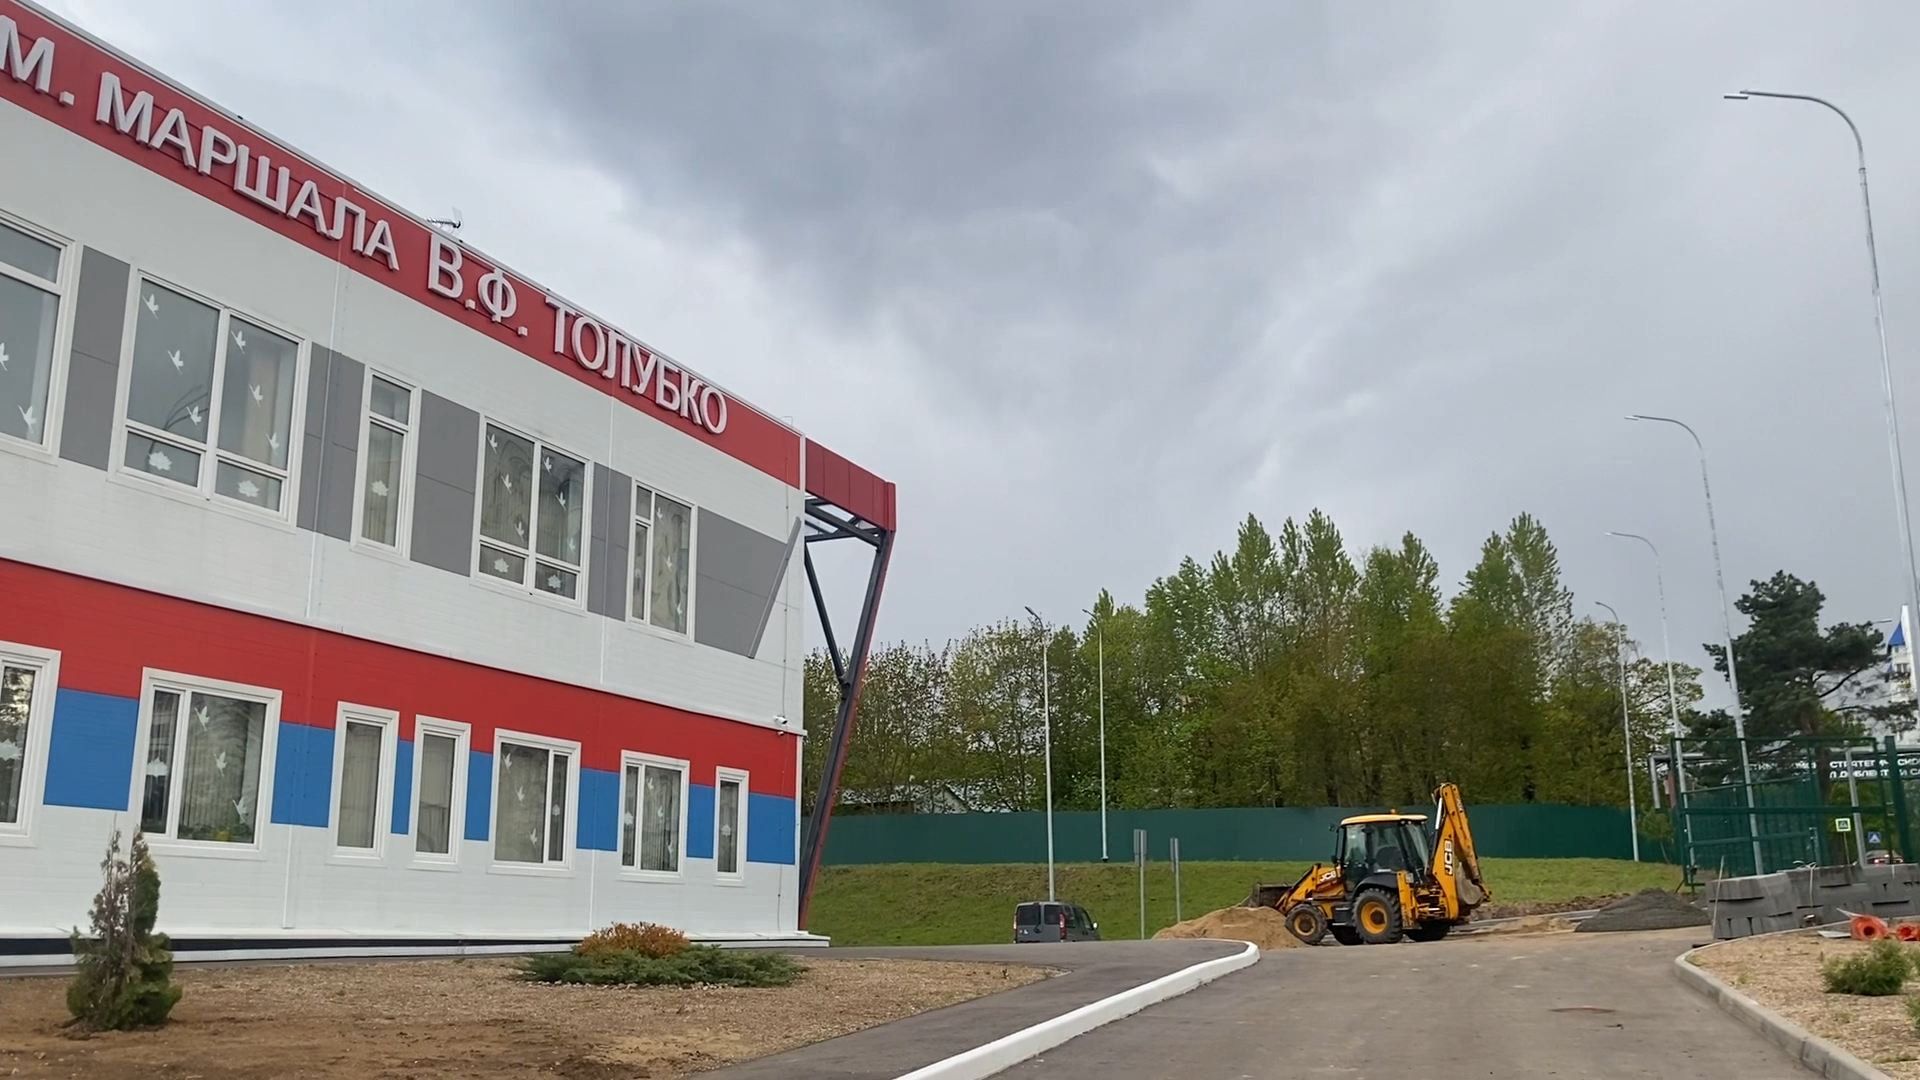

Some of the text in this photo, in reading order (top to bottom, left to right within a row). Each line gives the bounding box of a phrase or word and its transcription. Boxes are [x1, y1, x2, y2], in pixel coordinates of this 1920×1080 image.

[96, 71, 400, 271] МАРШАЛА
[427, 233, 528, 337] В.Ф.
[545, 294, 727, 435] ТОЛУБКО
[1319, 870, 1337, 883] JCB
[1443, 839, 1454, 877] JCB
